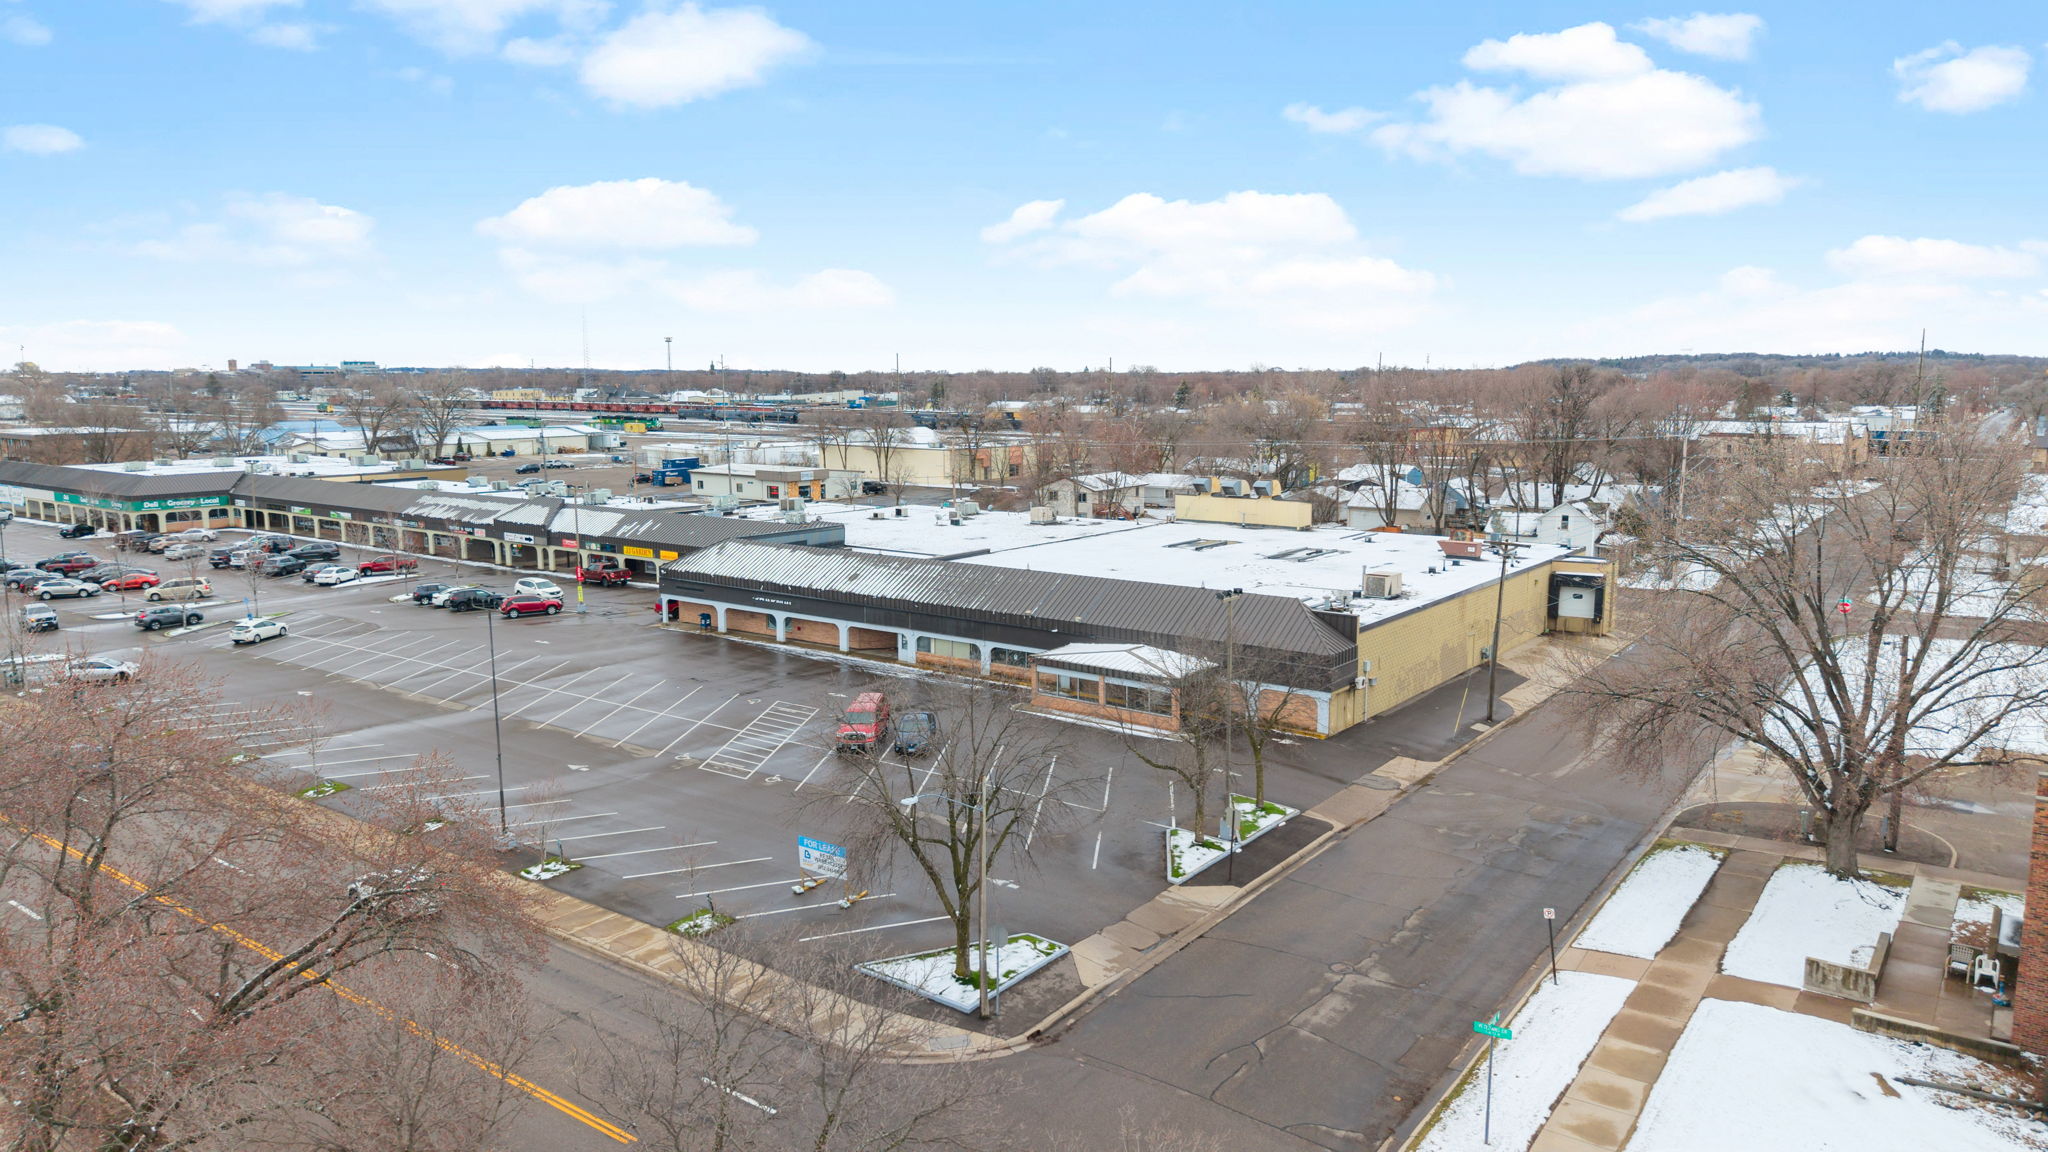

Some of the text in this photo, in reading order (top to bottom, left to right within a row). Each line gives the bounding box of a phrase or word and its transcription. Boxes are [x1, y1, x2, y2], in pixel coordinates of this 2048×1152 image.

[200, 497, 219, 505] Local
[633, 548, 651, 556] GARDEN
[803, 838, 841, 855] FOR LEASE
